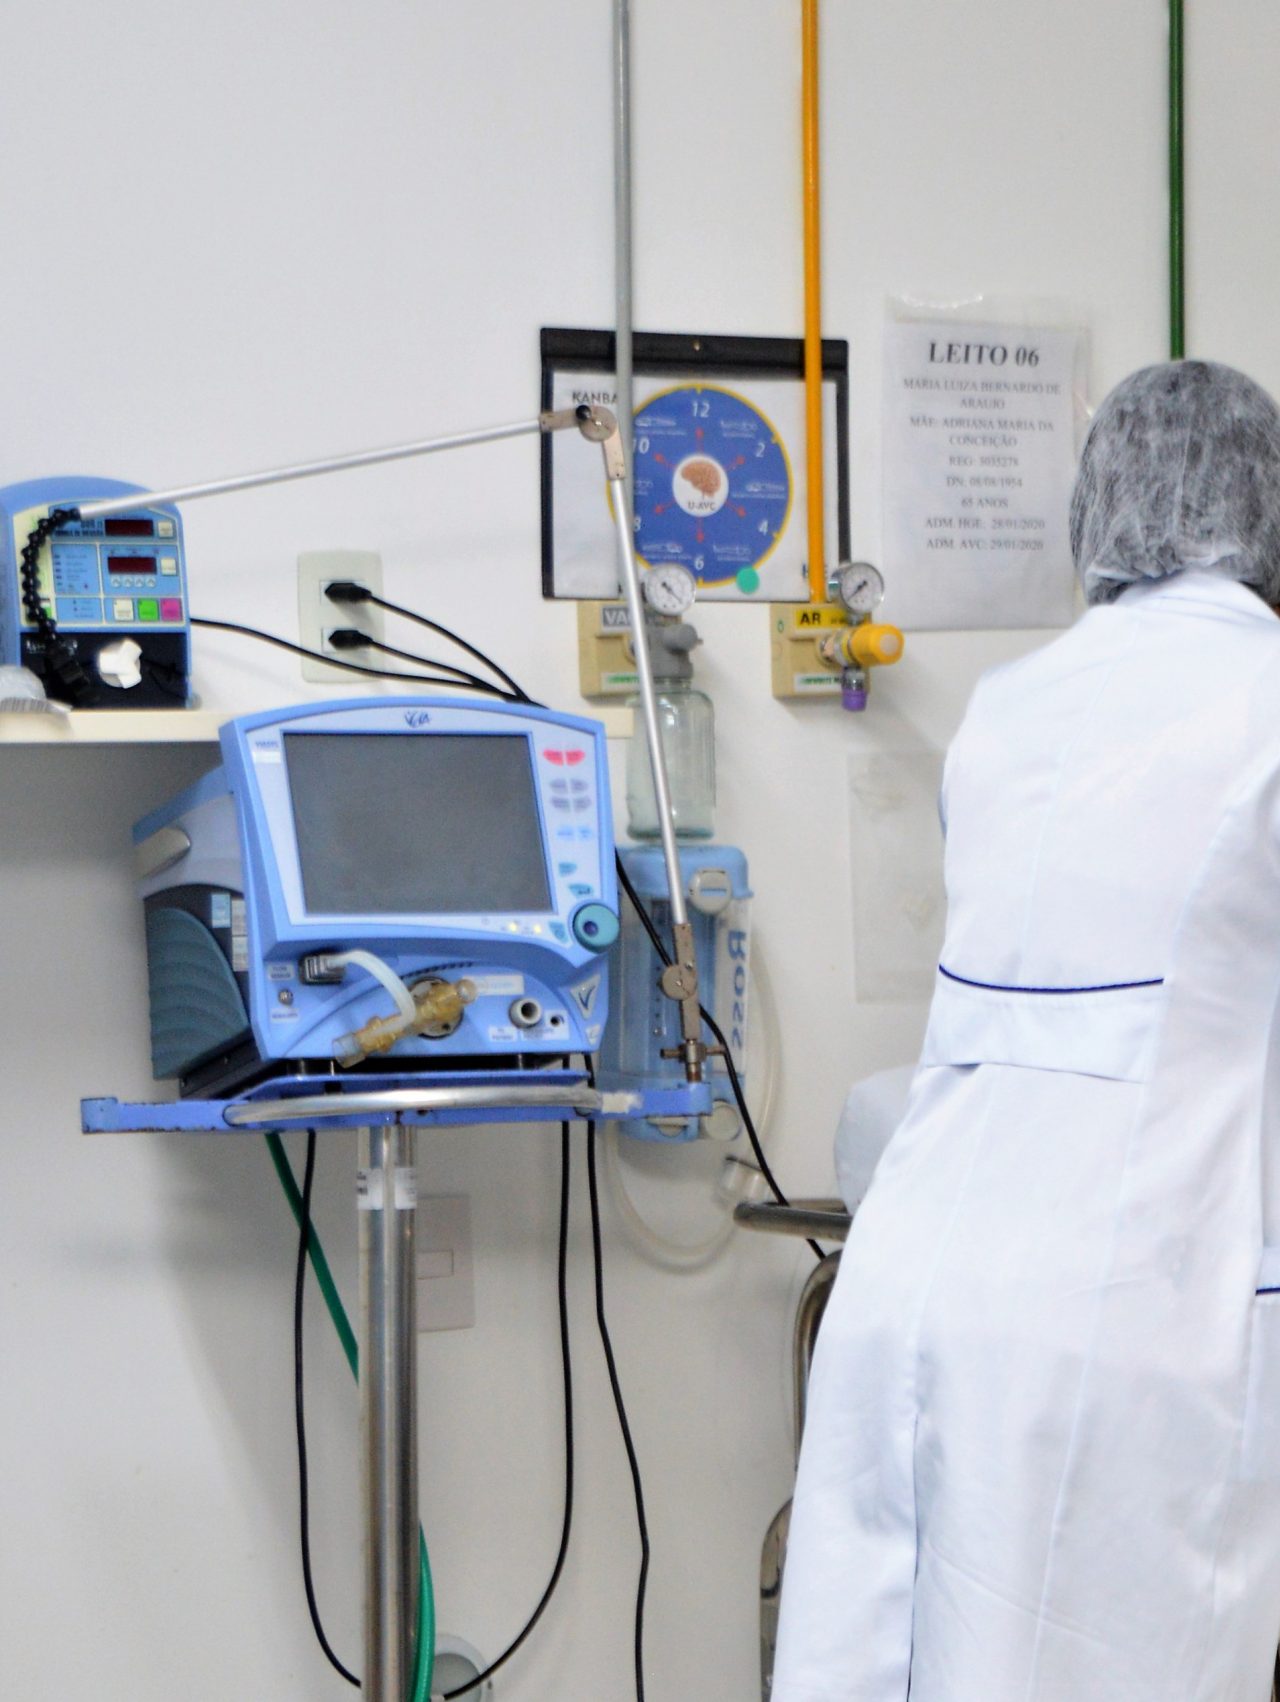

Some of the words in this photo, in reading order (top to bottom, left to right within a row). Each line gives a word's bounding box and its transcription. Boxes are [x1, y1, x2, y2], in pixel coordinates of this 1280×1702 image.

[929, 341, 1008, 366] LEITO
[1015, 346, 1039, 368] 06
[903, 377, 940, 391] MARIA
[980, 380, 1043, 394] BERNARDO
[1046, 383, 1060, 395] DE
[572, 391, 618, 405] KANBA
[692, 401, 710, 418] 12
[943, 417, 994, 431] ADRIANA
[997, 419, 1036, 432] MARIA
[1038, 420, 1054, 433] DA
[756, 442, 766, 458] 2
[977, 497, 1008, 509] ANOS
[758, 519, 769, 535] 4
[694, 555, 704, 571] 6
[800, 612, 821, 625] AR
